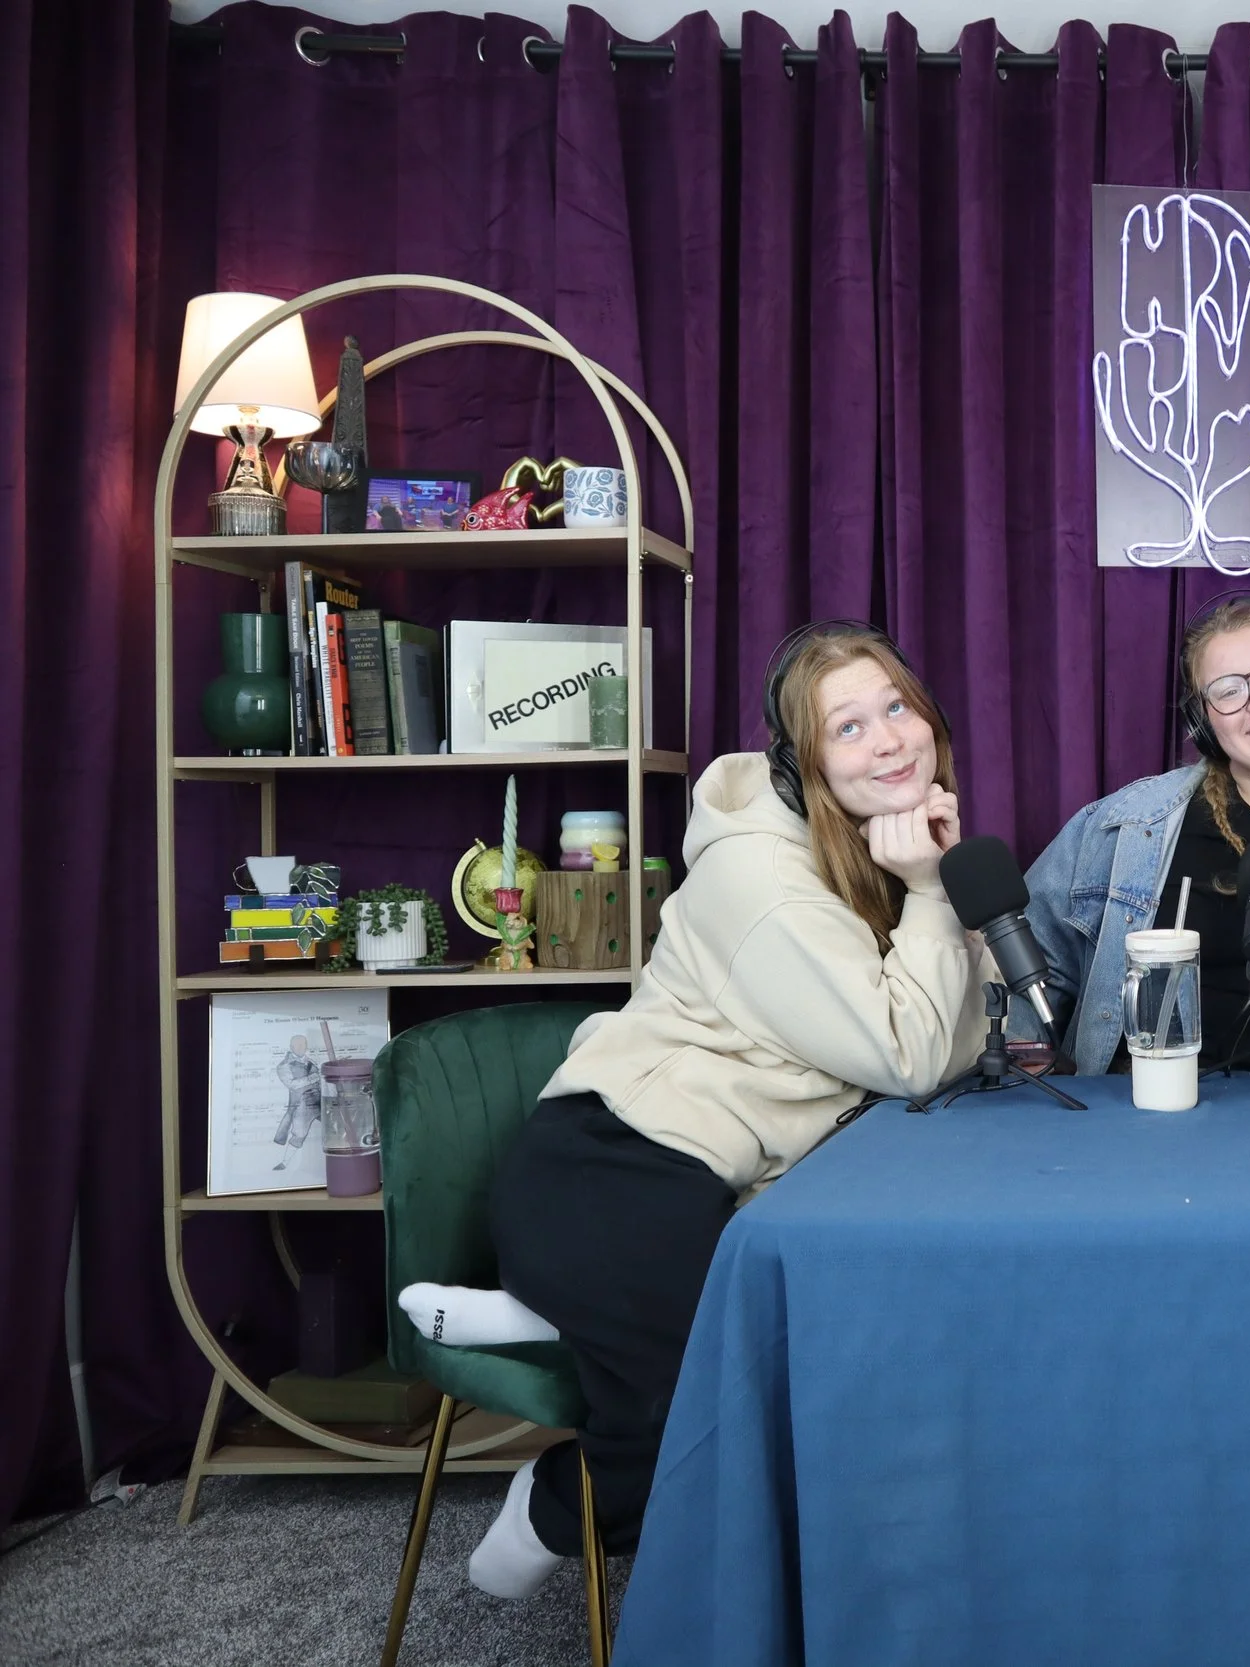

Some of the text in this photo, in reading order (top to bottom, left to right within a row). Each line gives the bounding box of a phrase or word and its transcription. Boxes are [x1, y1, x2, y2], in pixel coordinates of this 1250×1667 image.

[325, 581, 359, 609] Router
[320, 645, 329, 666] WHITE
[322, 667, 332, 699] FRAGILITY
[487, 661, 617, 731] RECORDING
